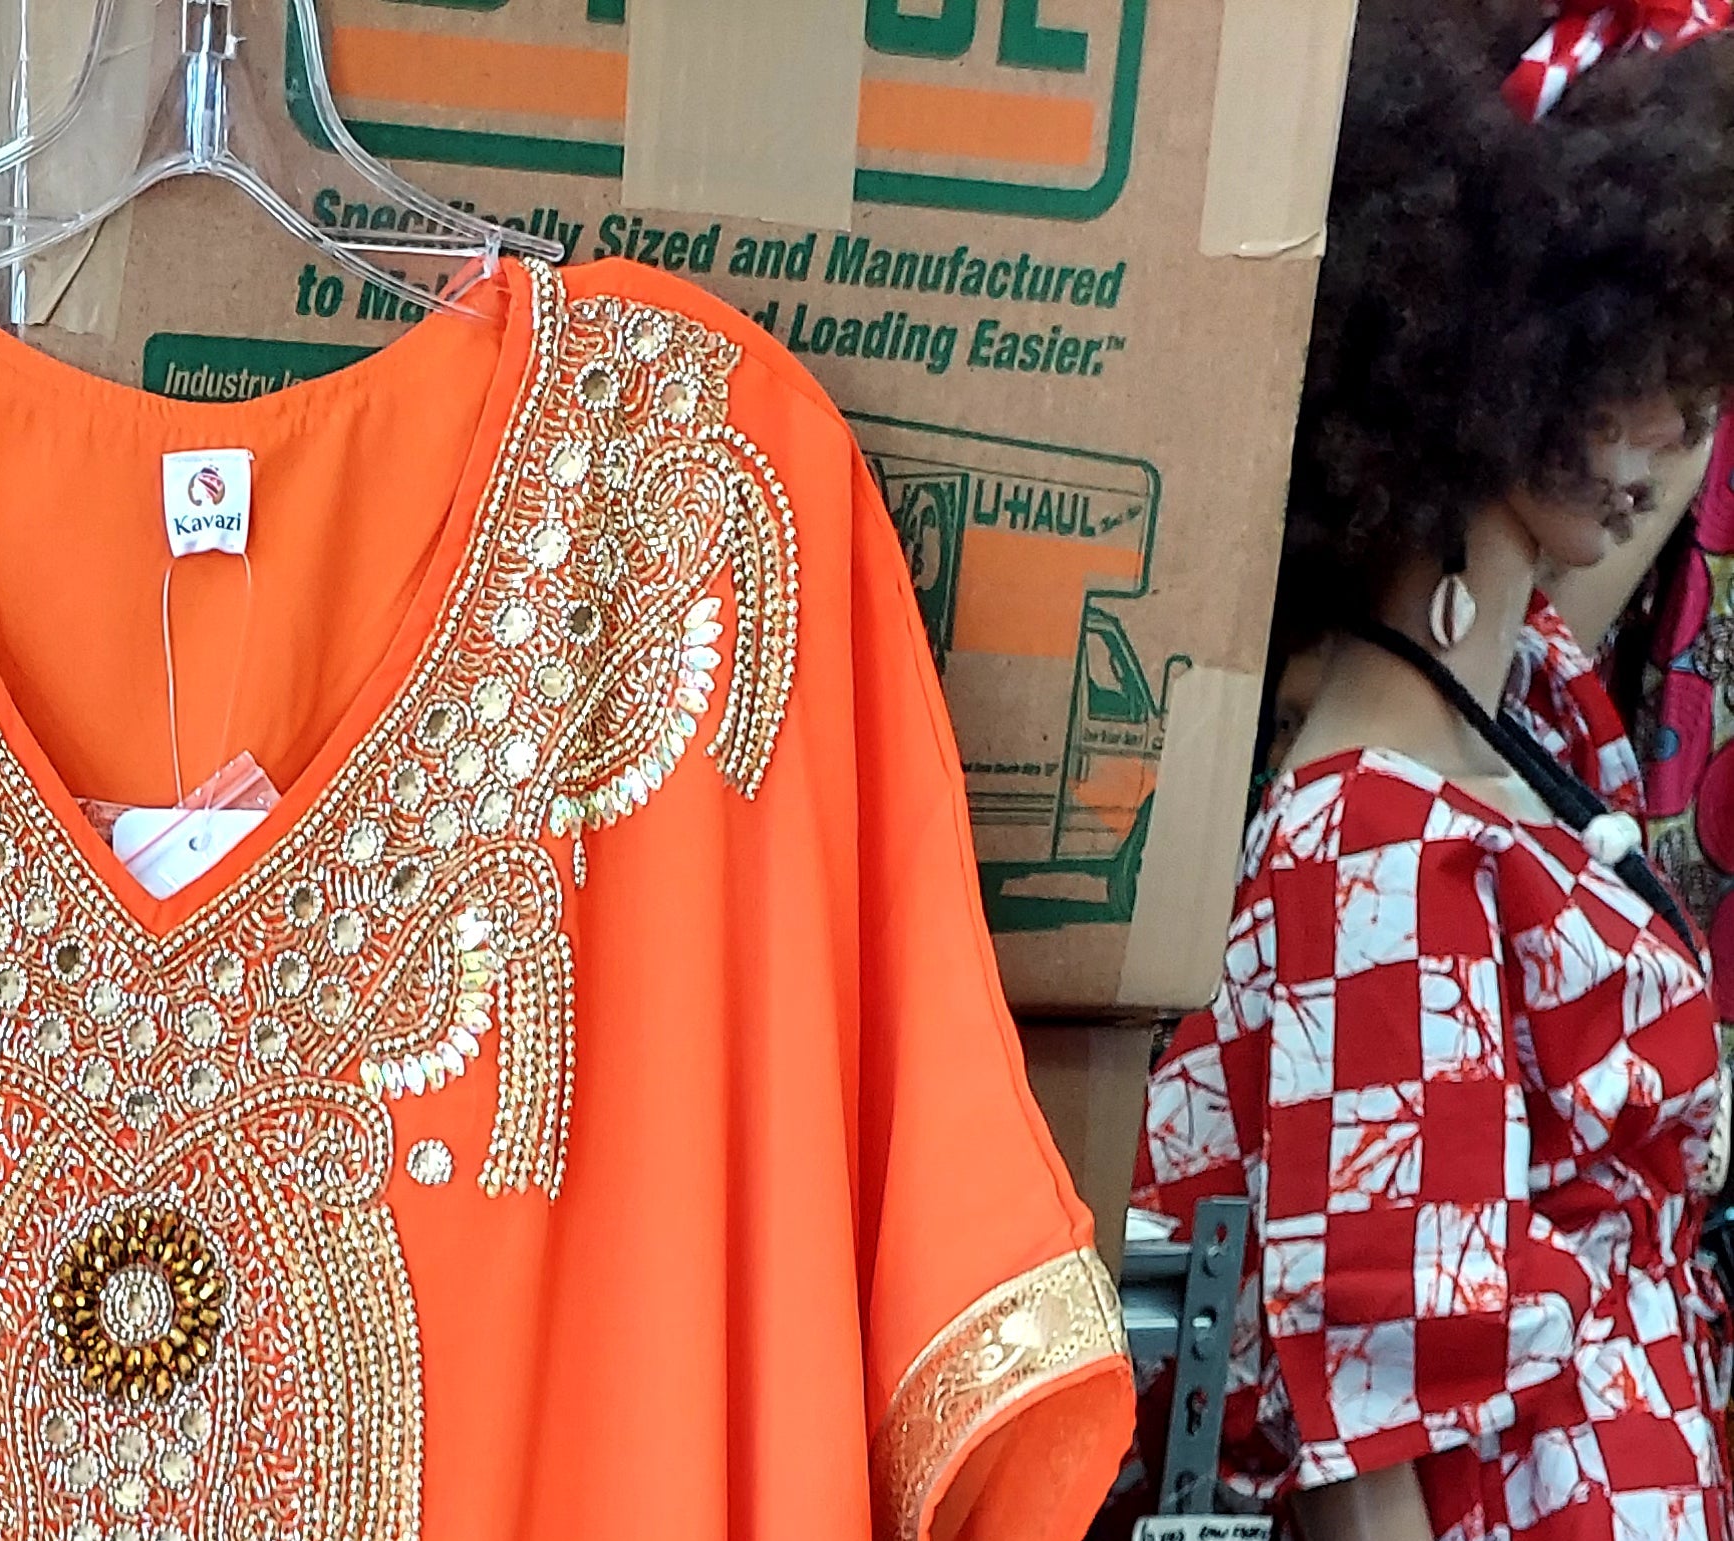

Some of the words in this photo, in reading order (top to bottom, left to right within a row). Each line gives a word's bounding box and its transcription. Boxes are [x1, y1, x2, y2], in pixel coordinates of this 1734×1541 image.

[593, 213, 721, 273] Sized
[729, 232, 817, 281] and
[825, 235, 1127, 309] Manufactured
[295, 263, 344, 317] to
[787, 306, 957, 374] Loading
[165, 361, 276, 400] Industry
[174, 512, 242, 536] Kavazi
[973, 479, 1096, 537] U-HAUL
